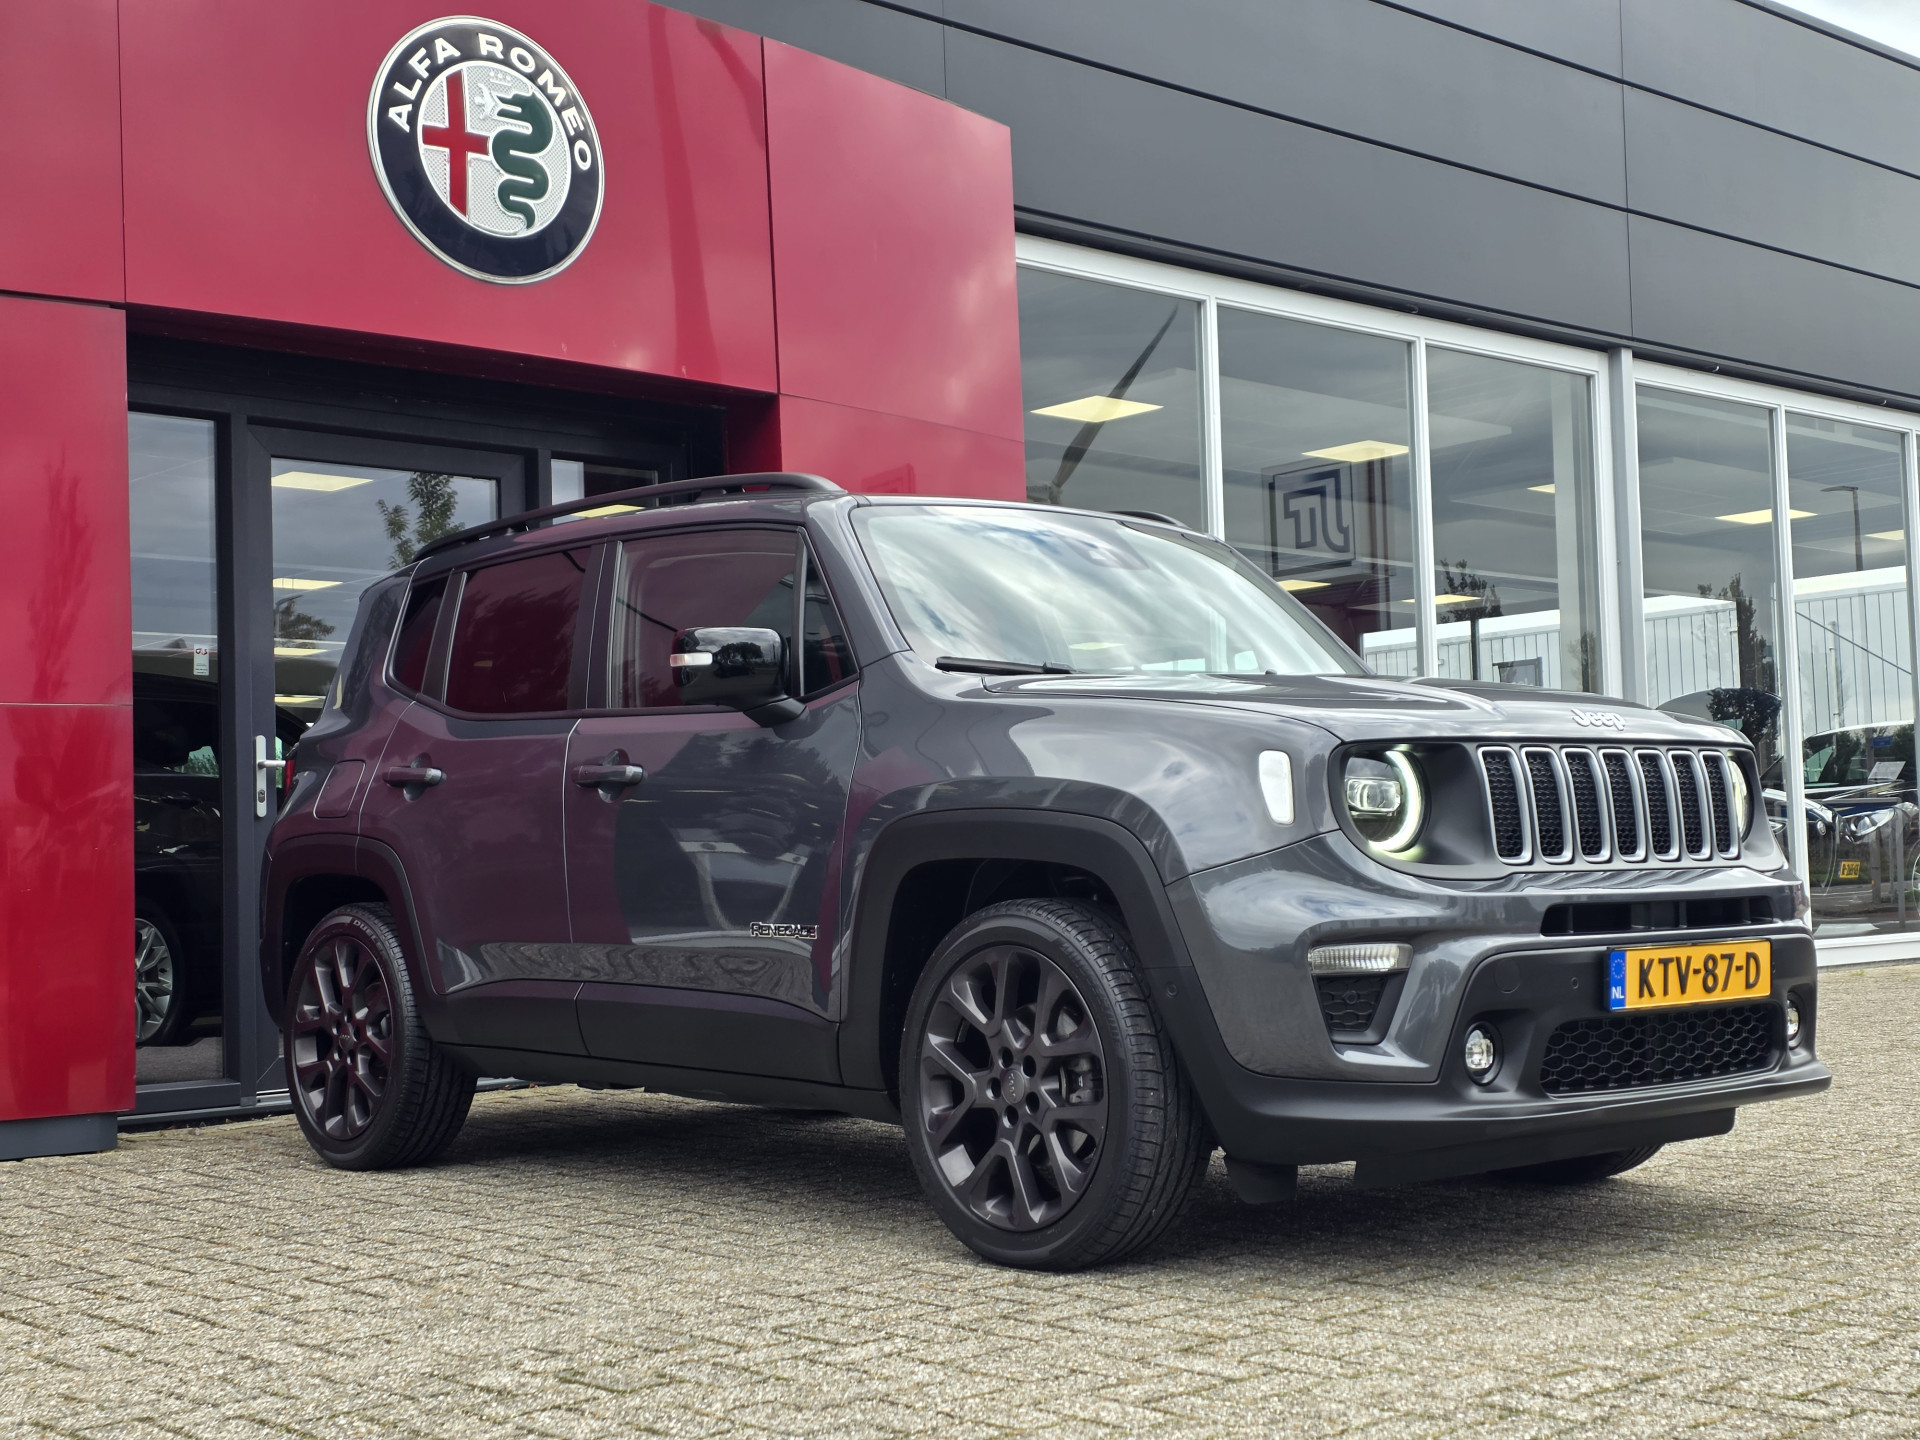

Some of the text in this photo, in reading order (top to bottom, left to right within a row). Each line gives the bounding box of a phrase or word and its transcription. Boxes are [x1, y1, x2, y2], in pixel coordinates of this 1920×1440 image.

[388, 33, 592, 171] ALFA ROMEO
[1570, 708, 1626, 732] Jeep
[749, 921, 818, 940] RENEGADE
[1638, 951, 1761, 999] KTV-87-D
[1611, 985, 1625, 999] NL
